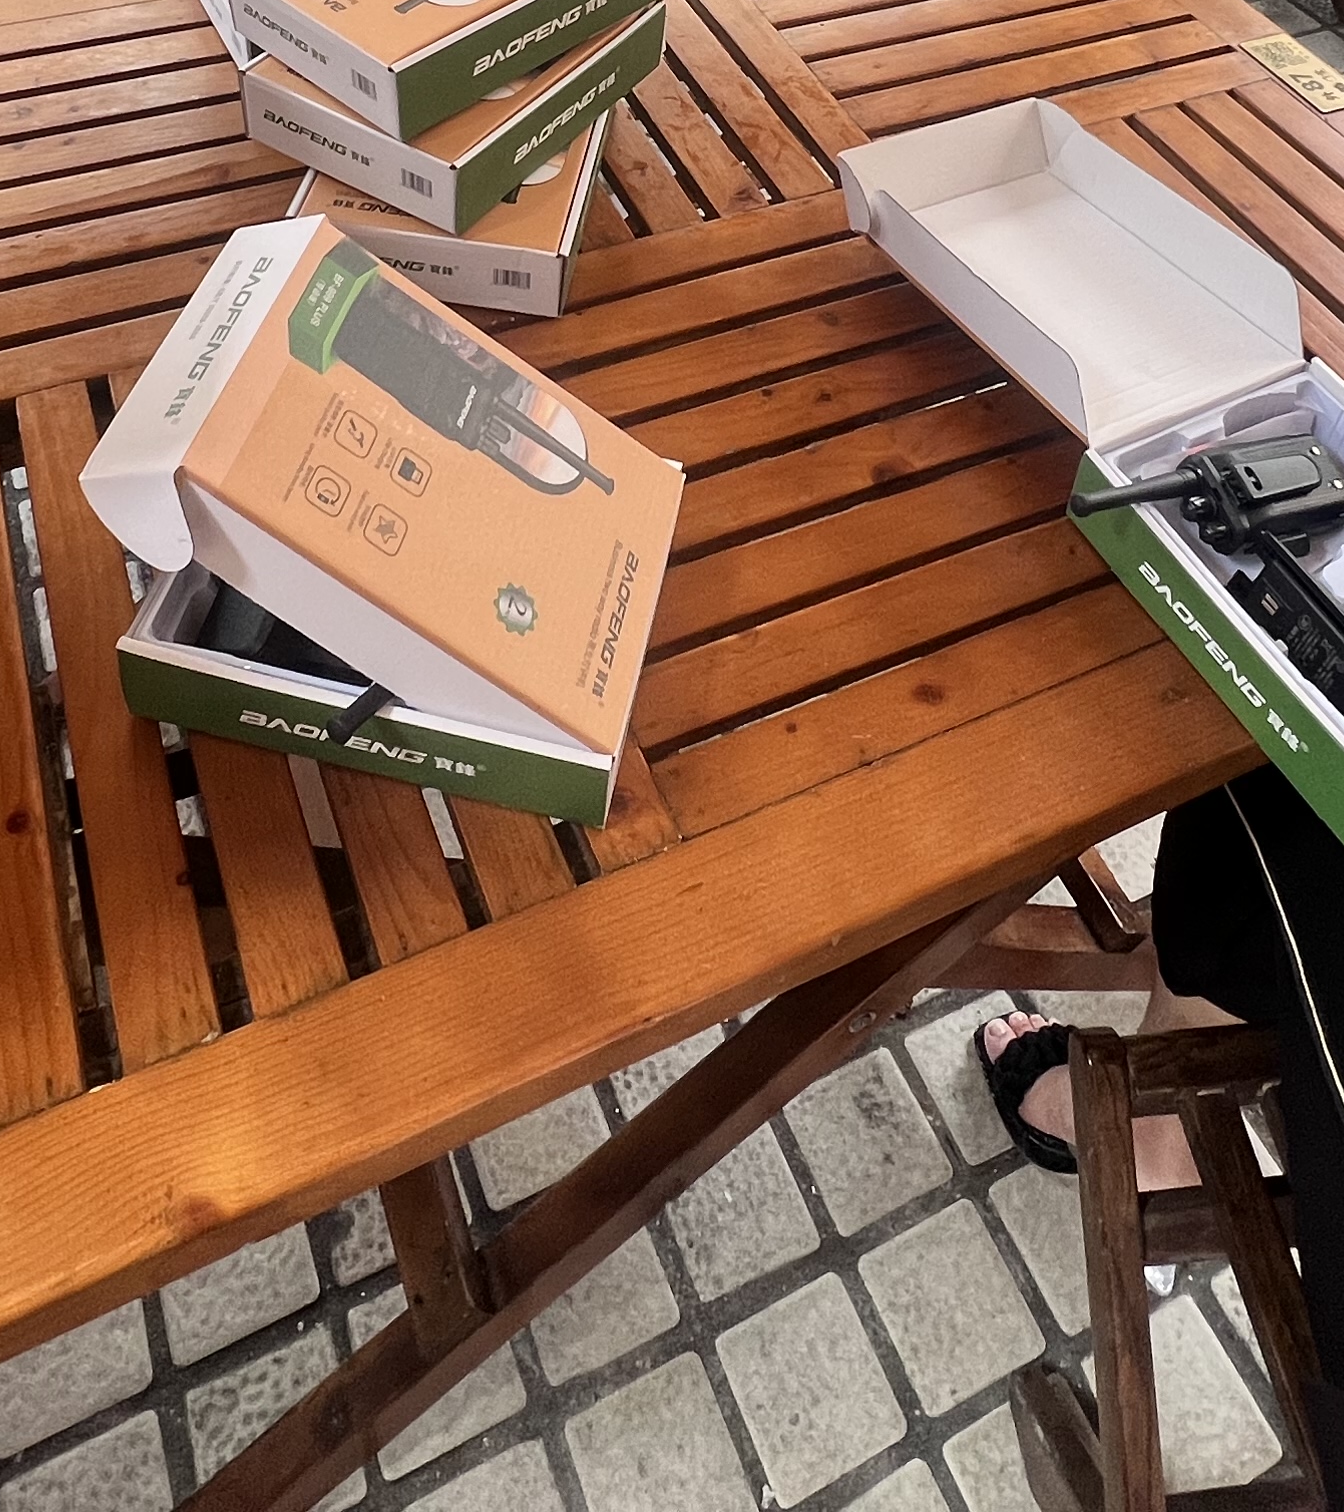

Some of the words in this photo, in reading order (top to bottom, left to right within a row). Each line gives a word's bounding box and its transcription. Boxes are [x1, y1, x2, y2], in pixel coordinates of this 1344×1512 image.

[243, 3, 309, 53] BAOFENG
[472, 4, 583, 77] BAOFENG
[263, 108, 348, 157] BAOFENG
[513, 86, 598, 165] BAOFENG
[187, 256, 274, 383] BAOFENG
[600, 549, 641, 670] BAOFENG
[1137, 560, 1268, 709] BAOFENG
